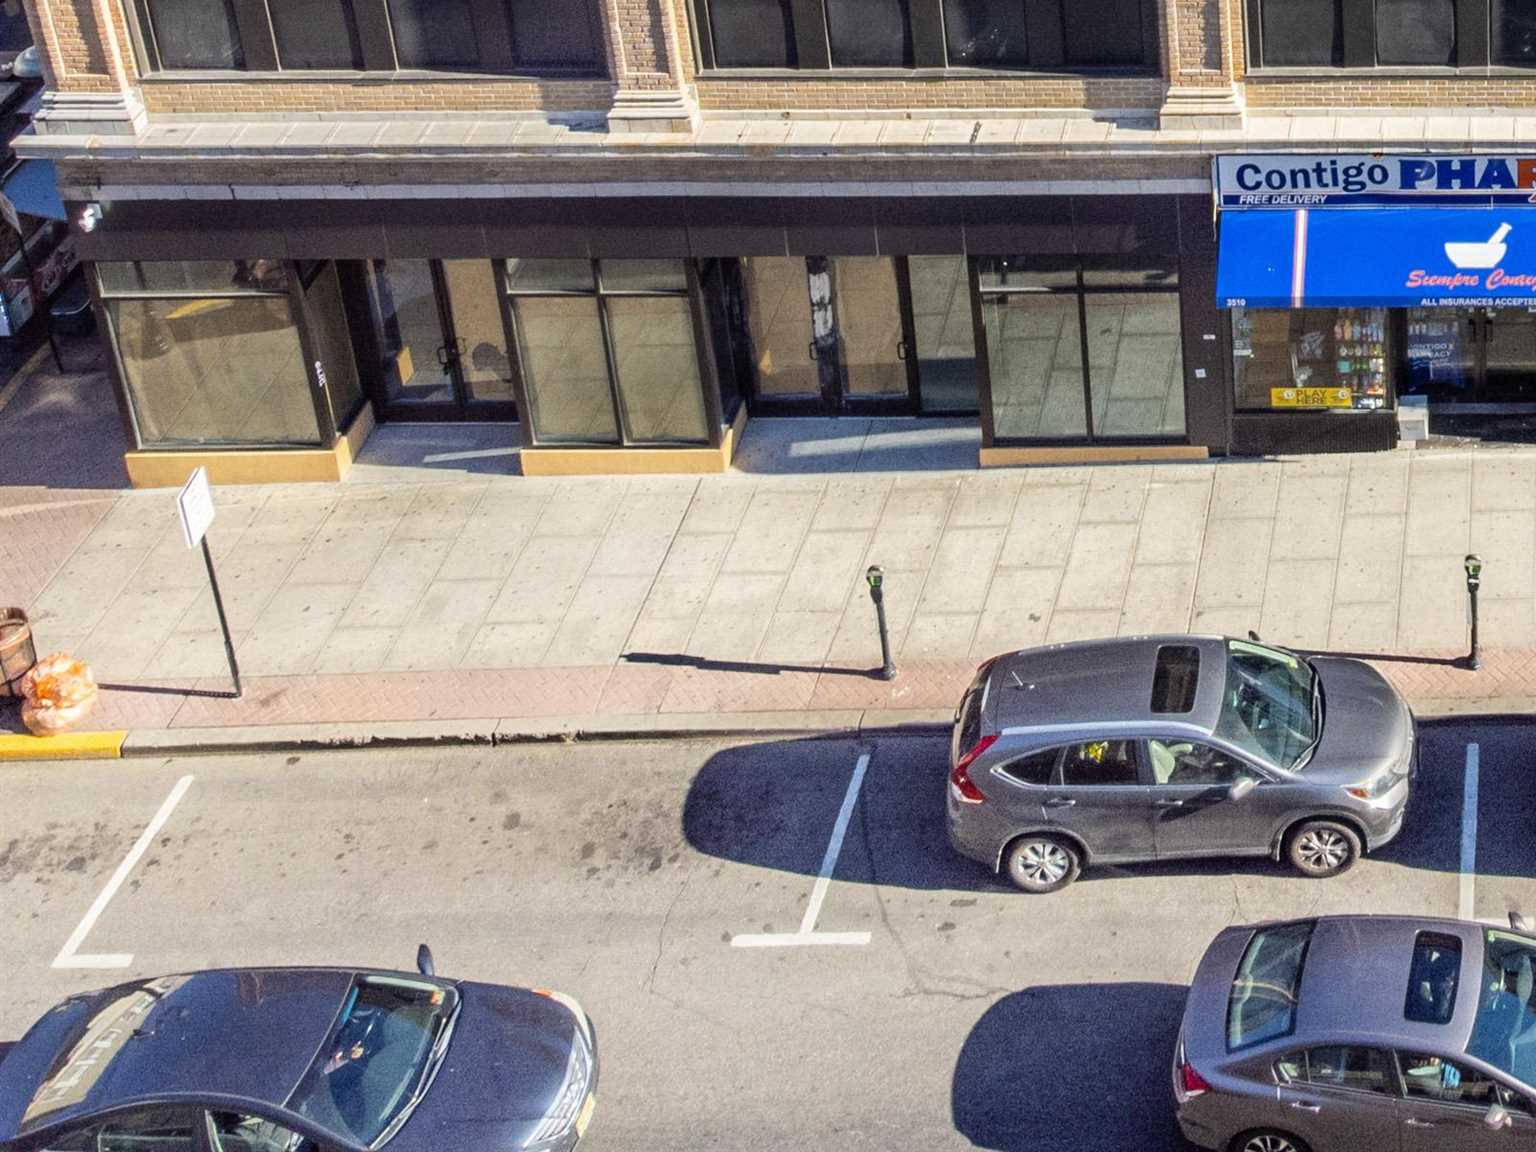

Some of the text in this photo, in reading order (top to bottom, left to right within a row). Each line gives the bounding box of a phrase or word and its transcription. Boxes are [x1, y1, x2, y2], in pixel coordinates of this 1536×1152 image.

[1236, 160, 1389, 192] Contigo
[1239, 194, 1328, 205] FREE DELIVERY
[1405, 269, 1480, 290] Siempre
[1226, 298, 1246, 306] 3510
[1420, 298, 1437, 306] ALL
[1439, 298, 1494, 306] INSURANCES
[1296, 389, 1327, 398] PLAY
